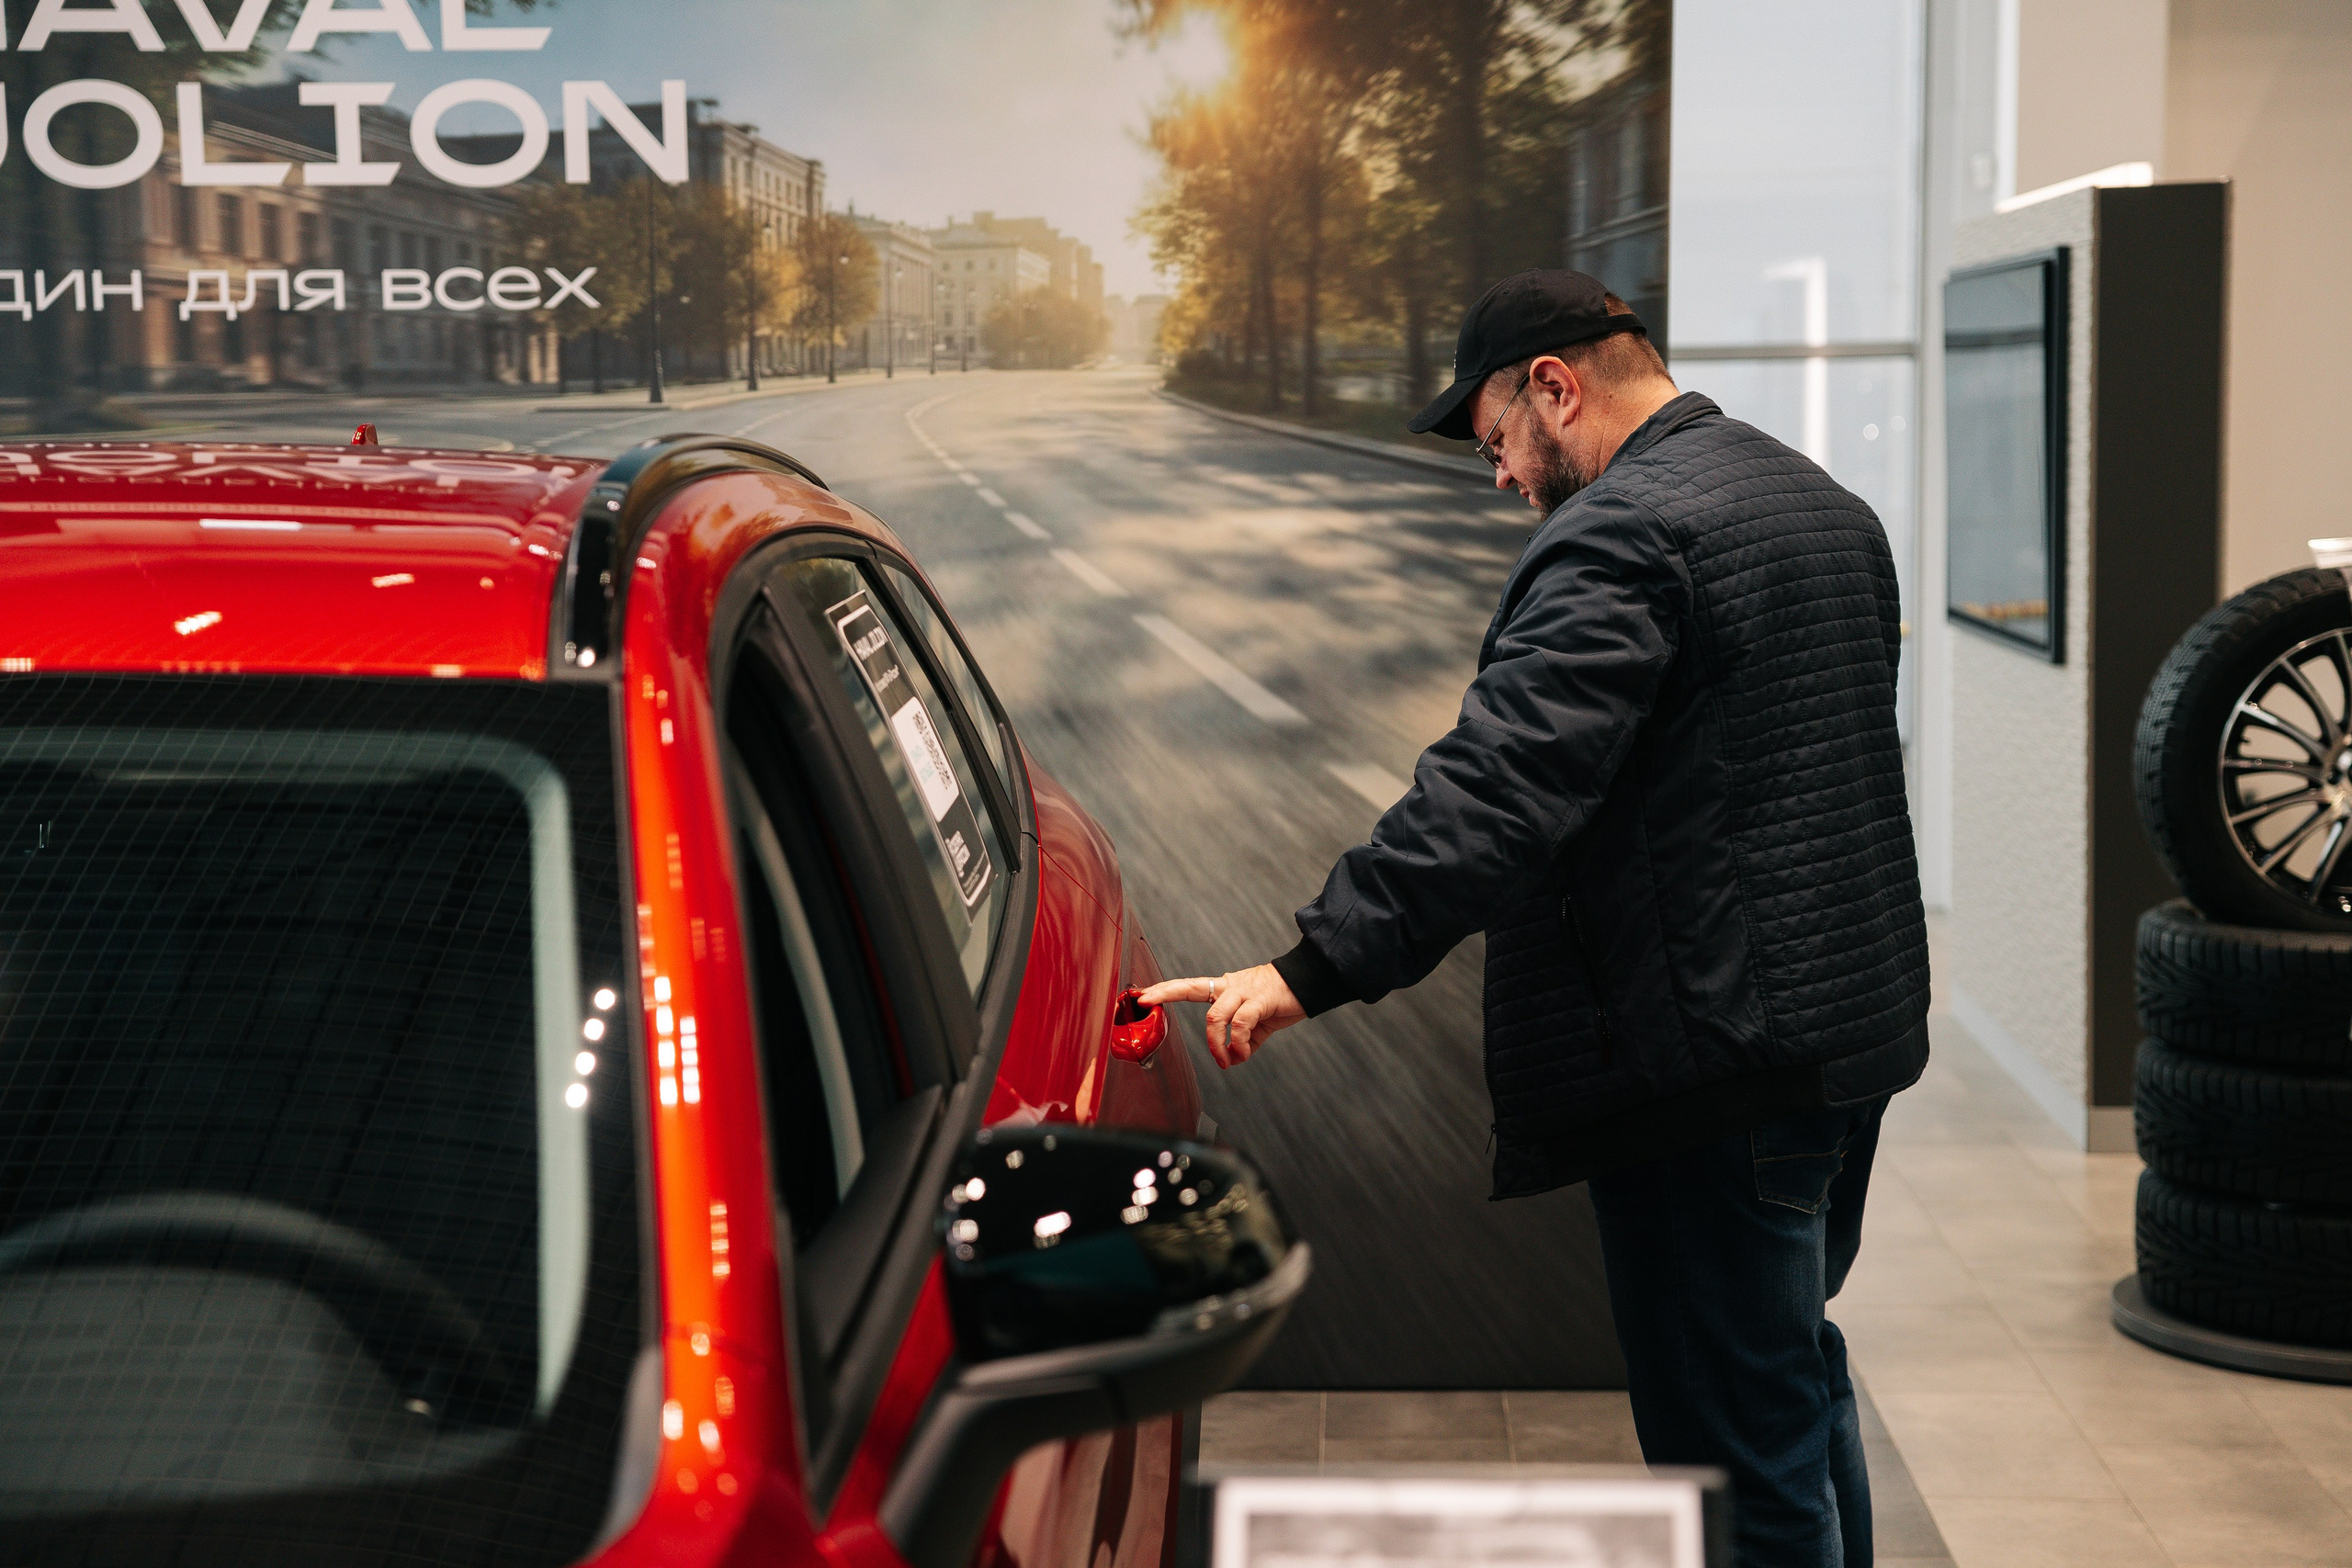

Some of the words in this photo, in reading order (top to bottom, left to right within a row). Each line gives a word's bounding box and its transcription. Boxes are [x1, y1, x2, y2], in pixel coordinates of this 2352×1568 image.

[0, 0, 551, 51] AVAL
[0, 78, 689, 188] OLION
[179, 269, 346, 321] для
[381, 266, 601, 310] всех
